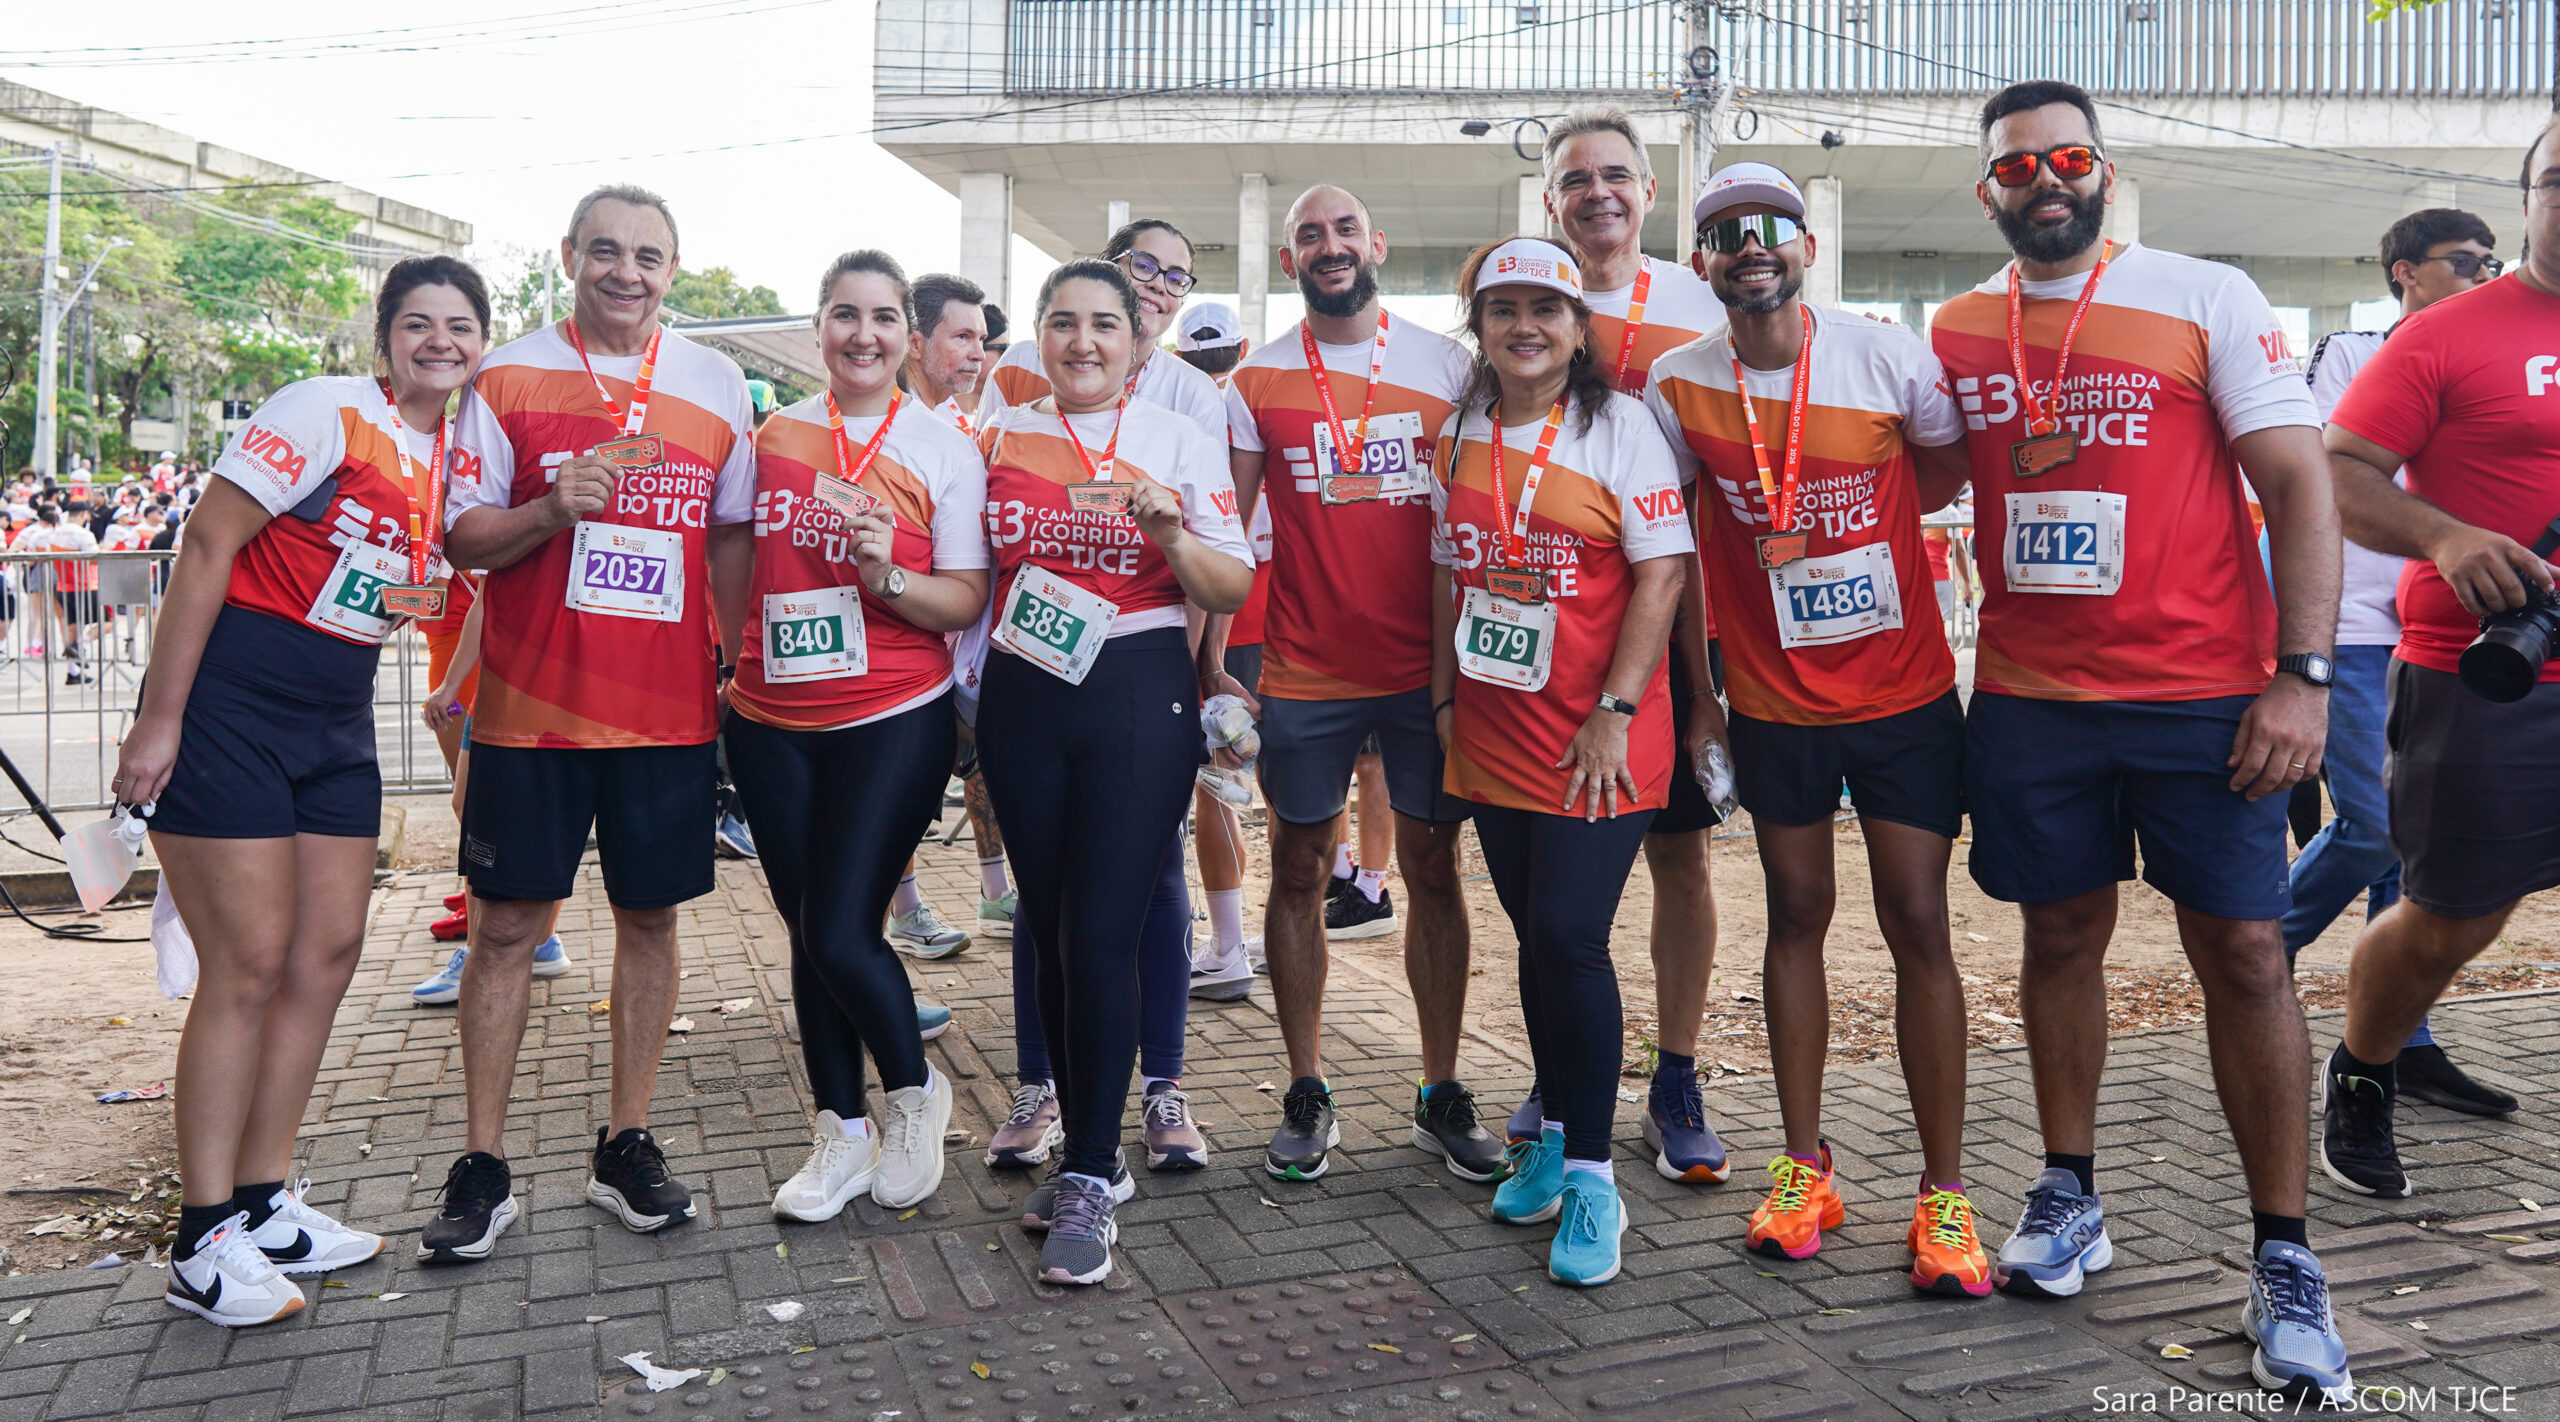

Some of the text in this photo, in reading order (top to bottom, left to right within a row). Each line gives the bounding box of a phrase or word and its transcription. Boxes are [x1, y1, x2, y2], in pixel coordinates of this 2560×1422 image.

[1529, 267, 1551, 279] TJCE
[2525, 355, 2560, 396] F
[1792, 415, 1800, 428] DO
[2065, 413, 2149, 447] TJCE
[232, 450, 247, 461] em
[241, 424, 307, 487] VIDA
[1319, 433, 1327, 455] 10KM
[624, 461, 716, 483] CAMINHADA
[1796, 467, 1877, 494] AMINHADA
[617, 475, 711, 500] /CORRIDA
[1794, 482, 1875, 512] ORRIDA
[617, 493, 708, 529] DO TJCE
[1038, 507, 1137, 528] CAMINHAD
[1818, 499, 1879, 539] TJCE
[2012, 508, 2020, 527] 5KM
[1030, 520, 1145, 545] /CORRIDA
[1646, 521, 1662, 532] em
[578, 533, 587, 556] 10KM
[792, 527, 858, 567] DO TJ
[1491, 531, 1585, 548] CNHADA
[2019, 525, 2096, 562] 1412
[340, 552, 354, 571] 3KM
[1029, 540, 1140, 575] DO TJCE
[1486, 544, 1579, 566] /CRRIDA
[586, 553, 665, 591] 2037
[1015, 573, 1026, 591] 3KM
[1776, 573, 1786, 591] 5KM
[347, 575, 390, 614] 51
[1793, 577, 1874, 618] 1486
[1019, 597, 1075, 645] 385
[1465, 601, 1473, 619] 3KM
[778, 619, 833, 655] 840
[1478, 622, 1529, 661] 679
